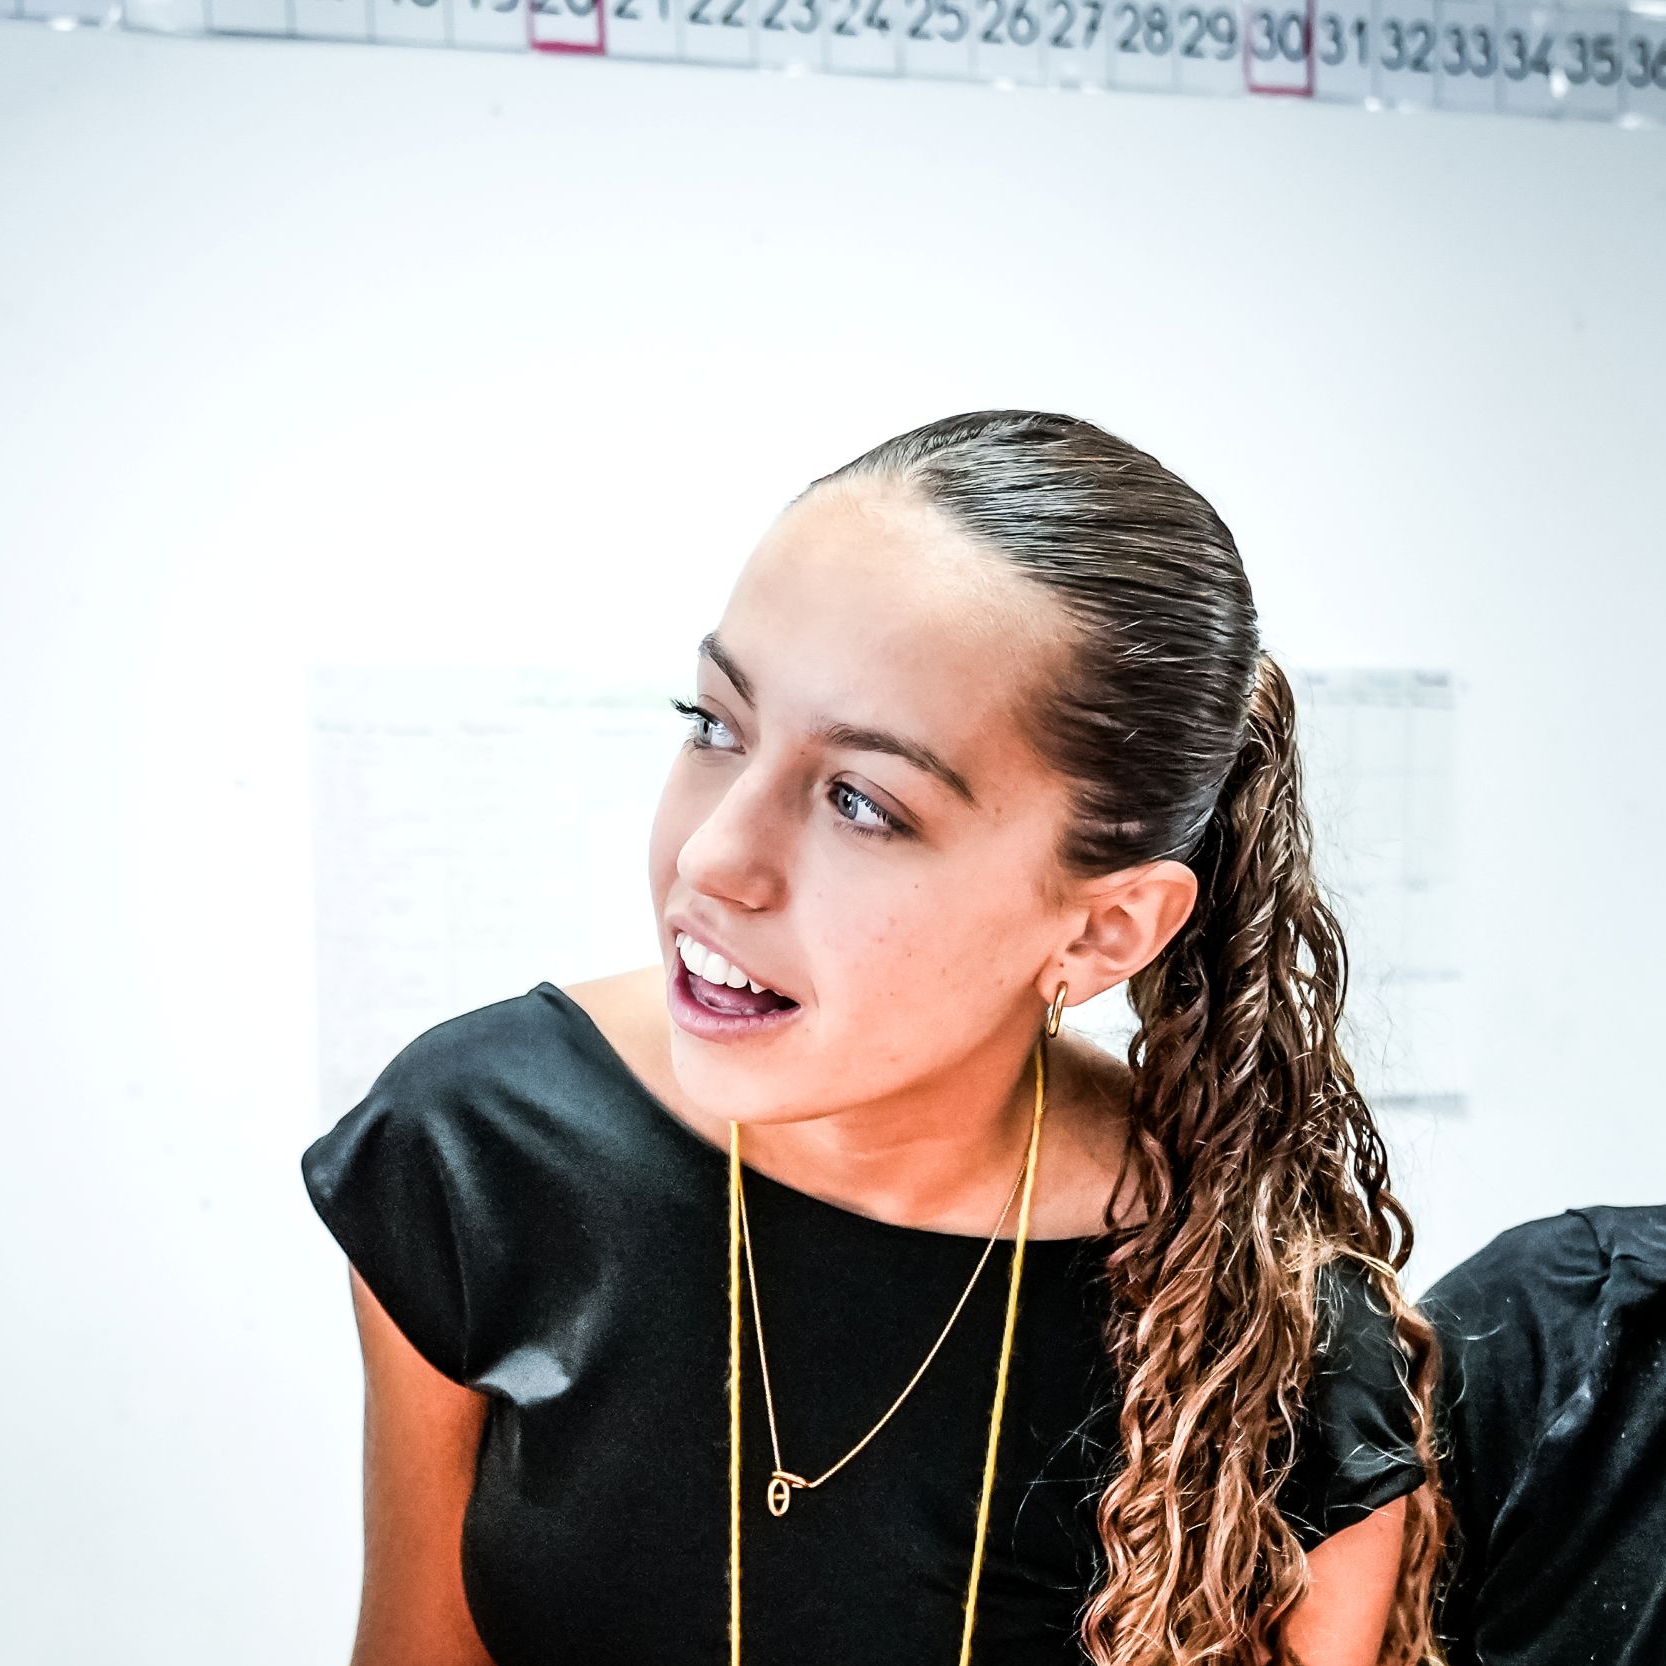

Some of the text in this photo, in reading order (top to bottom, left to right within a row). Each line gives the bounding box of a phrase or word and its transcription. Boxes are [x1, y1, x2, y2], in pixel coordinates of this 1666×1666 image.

[907, 0, 970, 43] 25
[980, 0, 1040, 47] 26
[1049, 0, 1103, 50] 27
[1118, 2, 1174, 56] 28
[1180, 8, 1237, 62] 29
[1250, 11, 1313, 63] 30
[1319, 14, 1369, 68] 31
[1381, 17, 1434, 73] 32
[1442, 23, 1498, 78] 33
[1503, 26, 1553, 81] 34
[1564, 31, 1623, 86] 35
